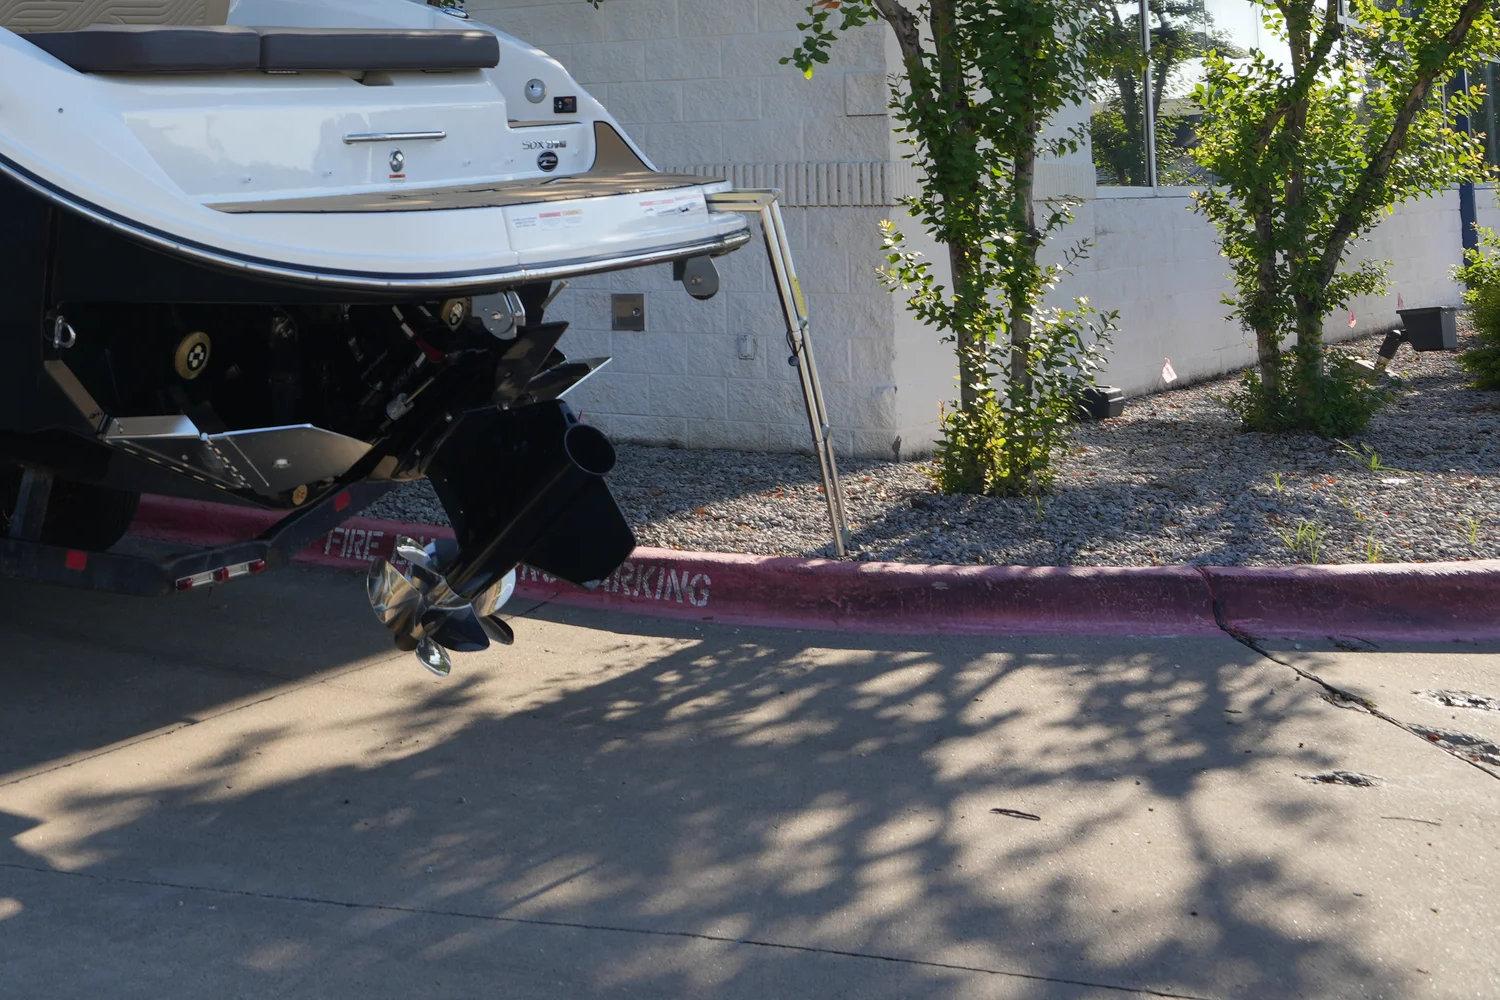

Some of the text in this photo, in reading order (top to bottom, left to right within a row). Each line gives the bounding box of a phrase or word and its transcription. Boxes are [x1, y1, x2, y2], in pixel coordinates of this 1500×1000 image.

[522, 140, 545, 150] SDX
[324, 527, 385, 562] FIRE
[599, 561, 712, 607] ARKING
